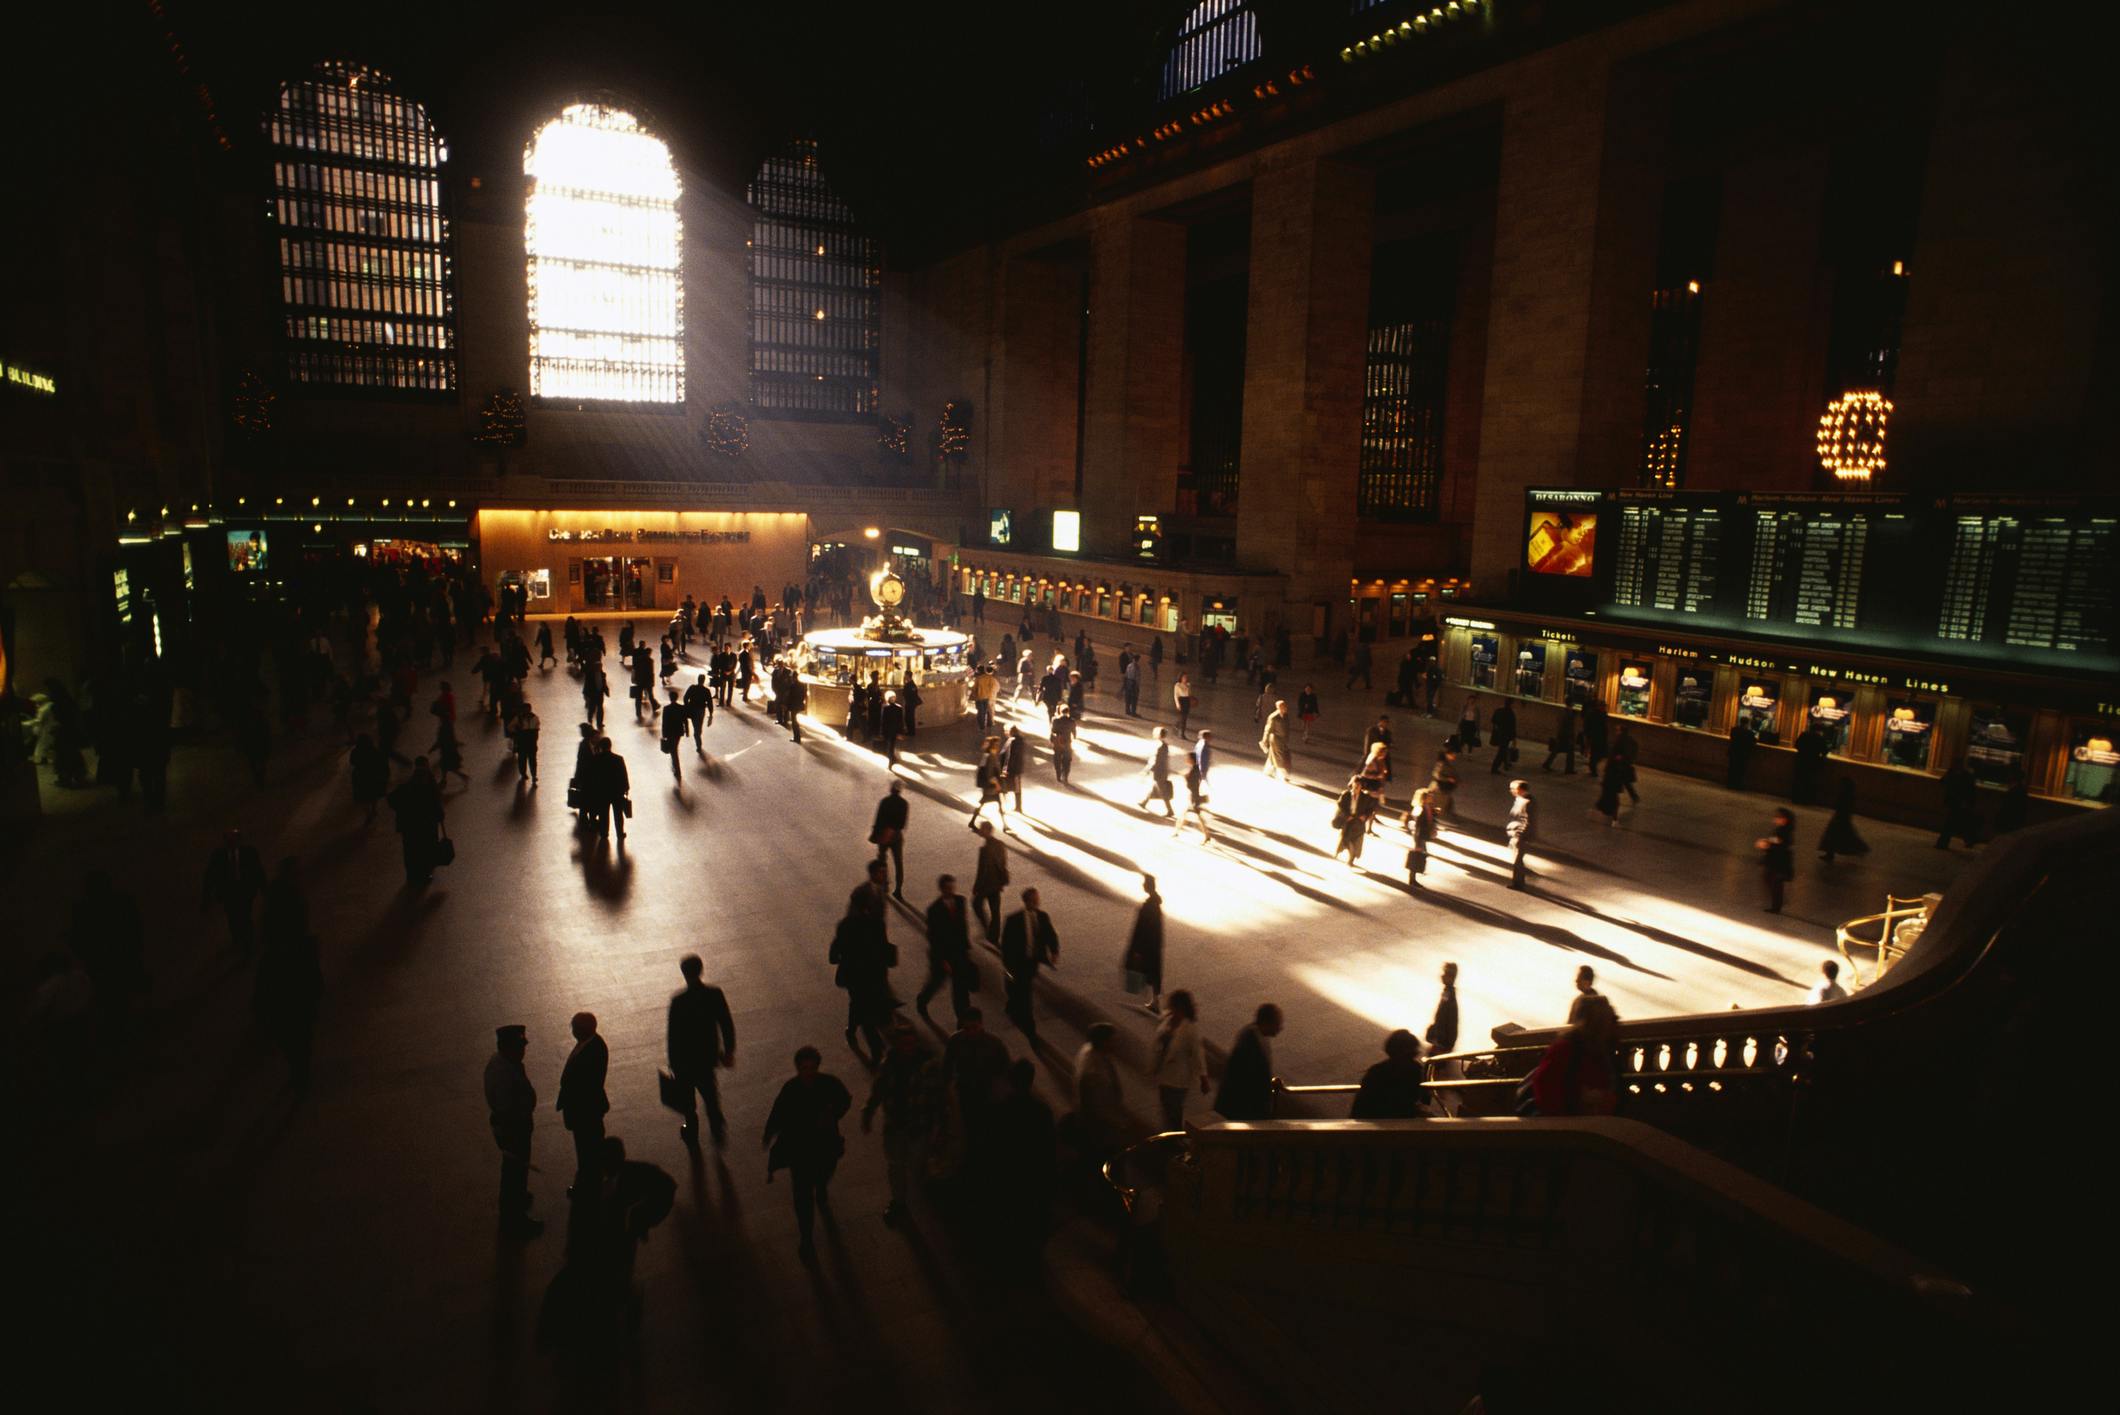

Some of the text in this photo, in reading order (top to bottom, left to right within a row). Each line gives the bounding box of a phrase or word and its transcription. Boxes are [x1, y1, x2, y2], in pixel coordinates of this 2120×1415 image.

[7, 366, 56, 393] BUILDING
[1535, 494, 1595, 502] DISARONNO
[1541, 629, 1576, 641] Tickets
[1658, 646, 1699, 658] Harlem
[1729, 655, 1775, 668] Hudson
[1810, 665, 1838, 677] New
[1845, 670, 1888, 684] Haven
[1905, 678, 1949, 693] Lines
